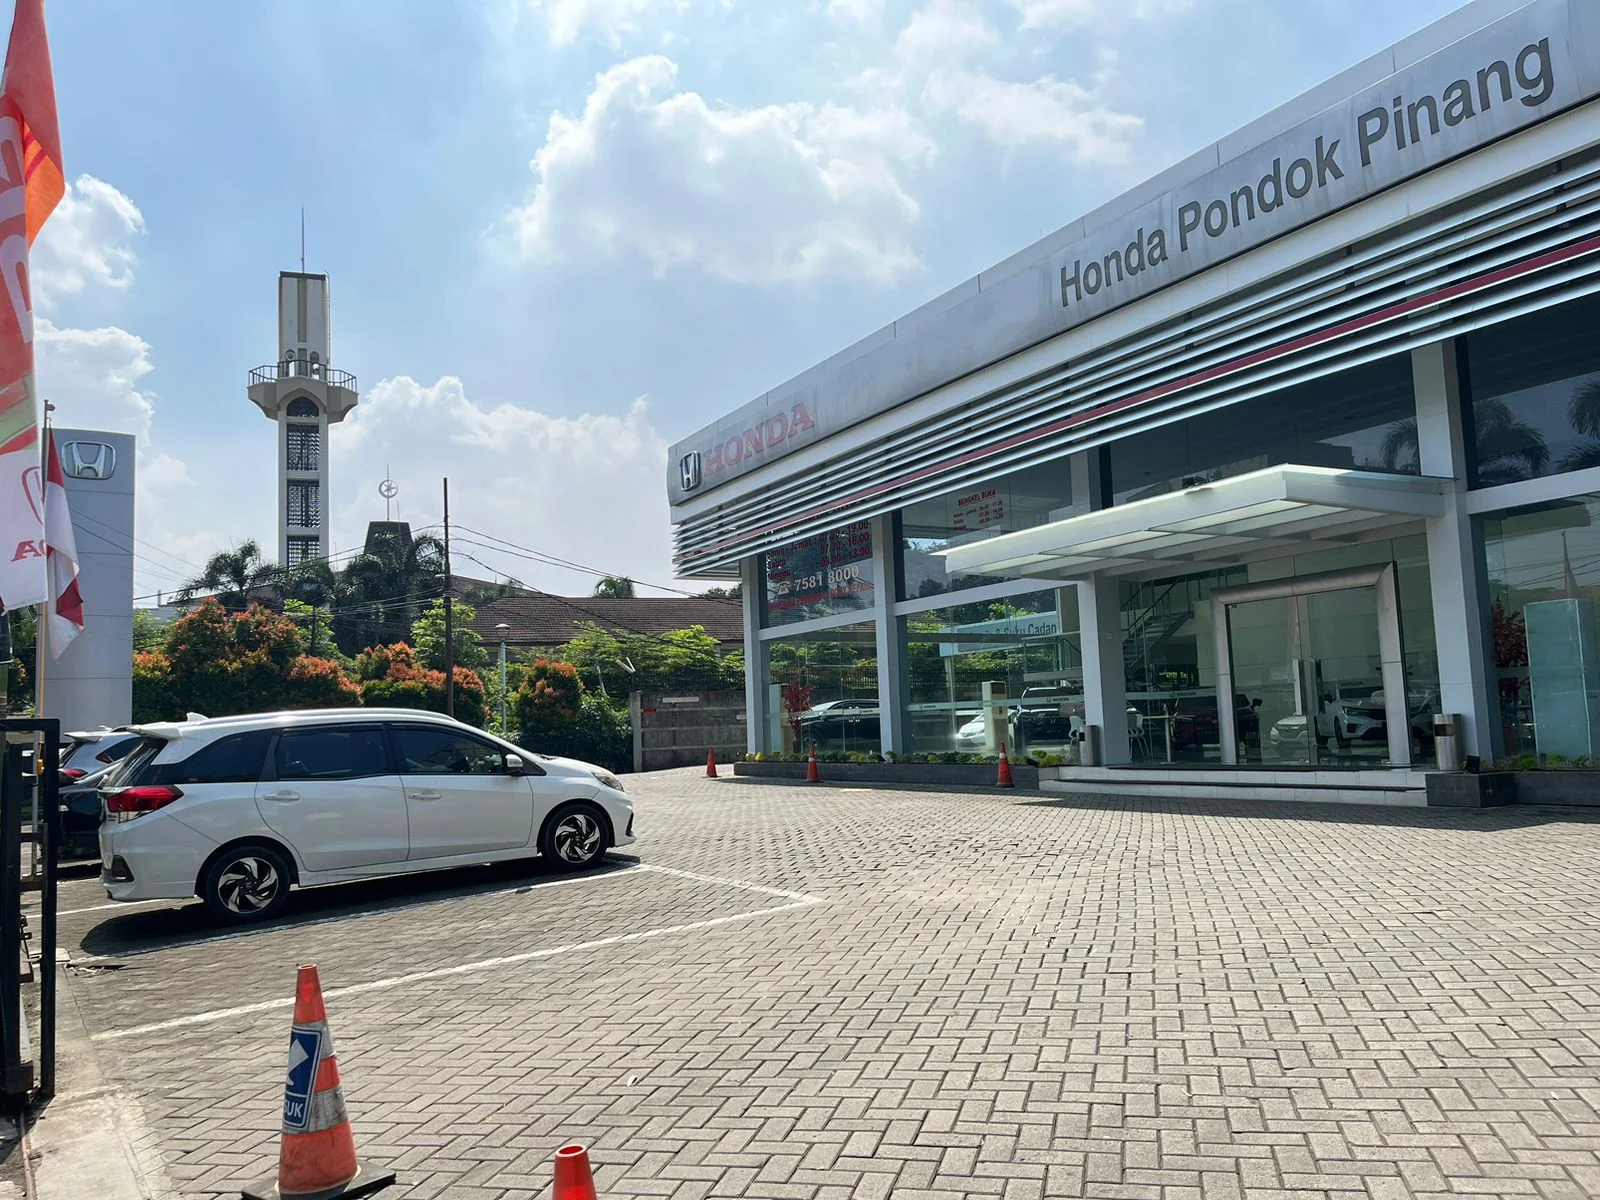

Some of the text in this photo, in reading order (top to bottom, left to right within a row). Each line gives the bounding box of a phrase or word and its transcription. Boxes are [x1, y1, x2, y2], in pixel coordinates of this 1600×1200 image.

[1060, 37, 1554, 307] Honda Pondok Pinang
[703, 402, 815, 477] HONDA
[794, 565, 859, 592] 7581 8000
